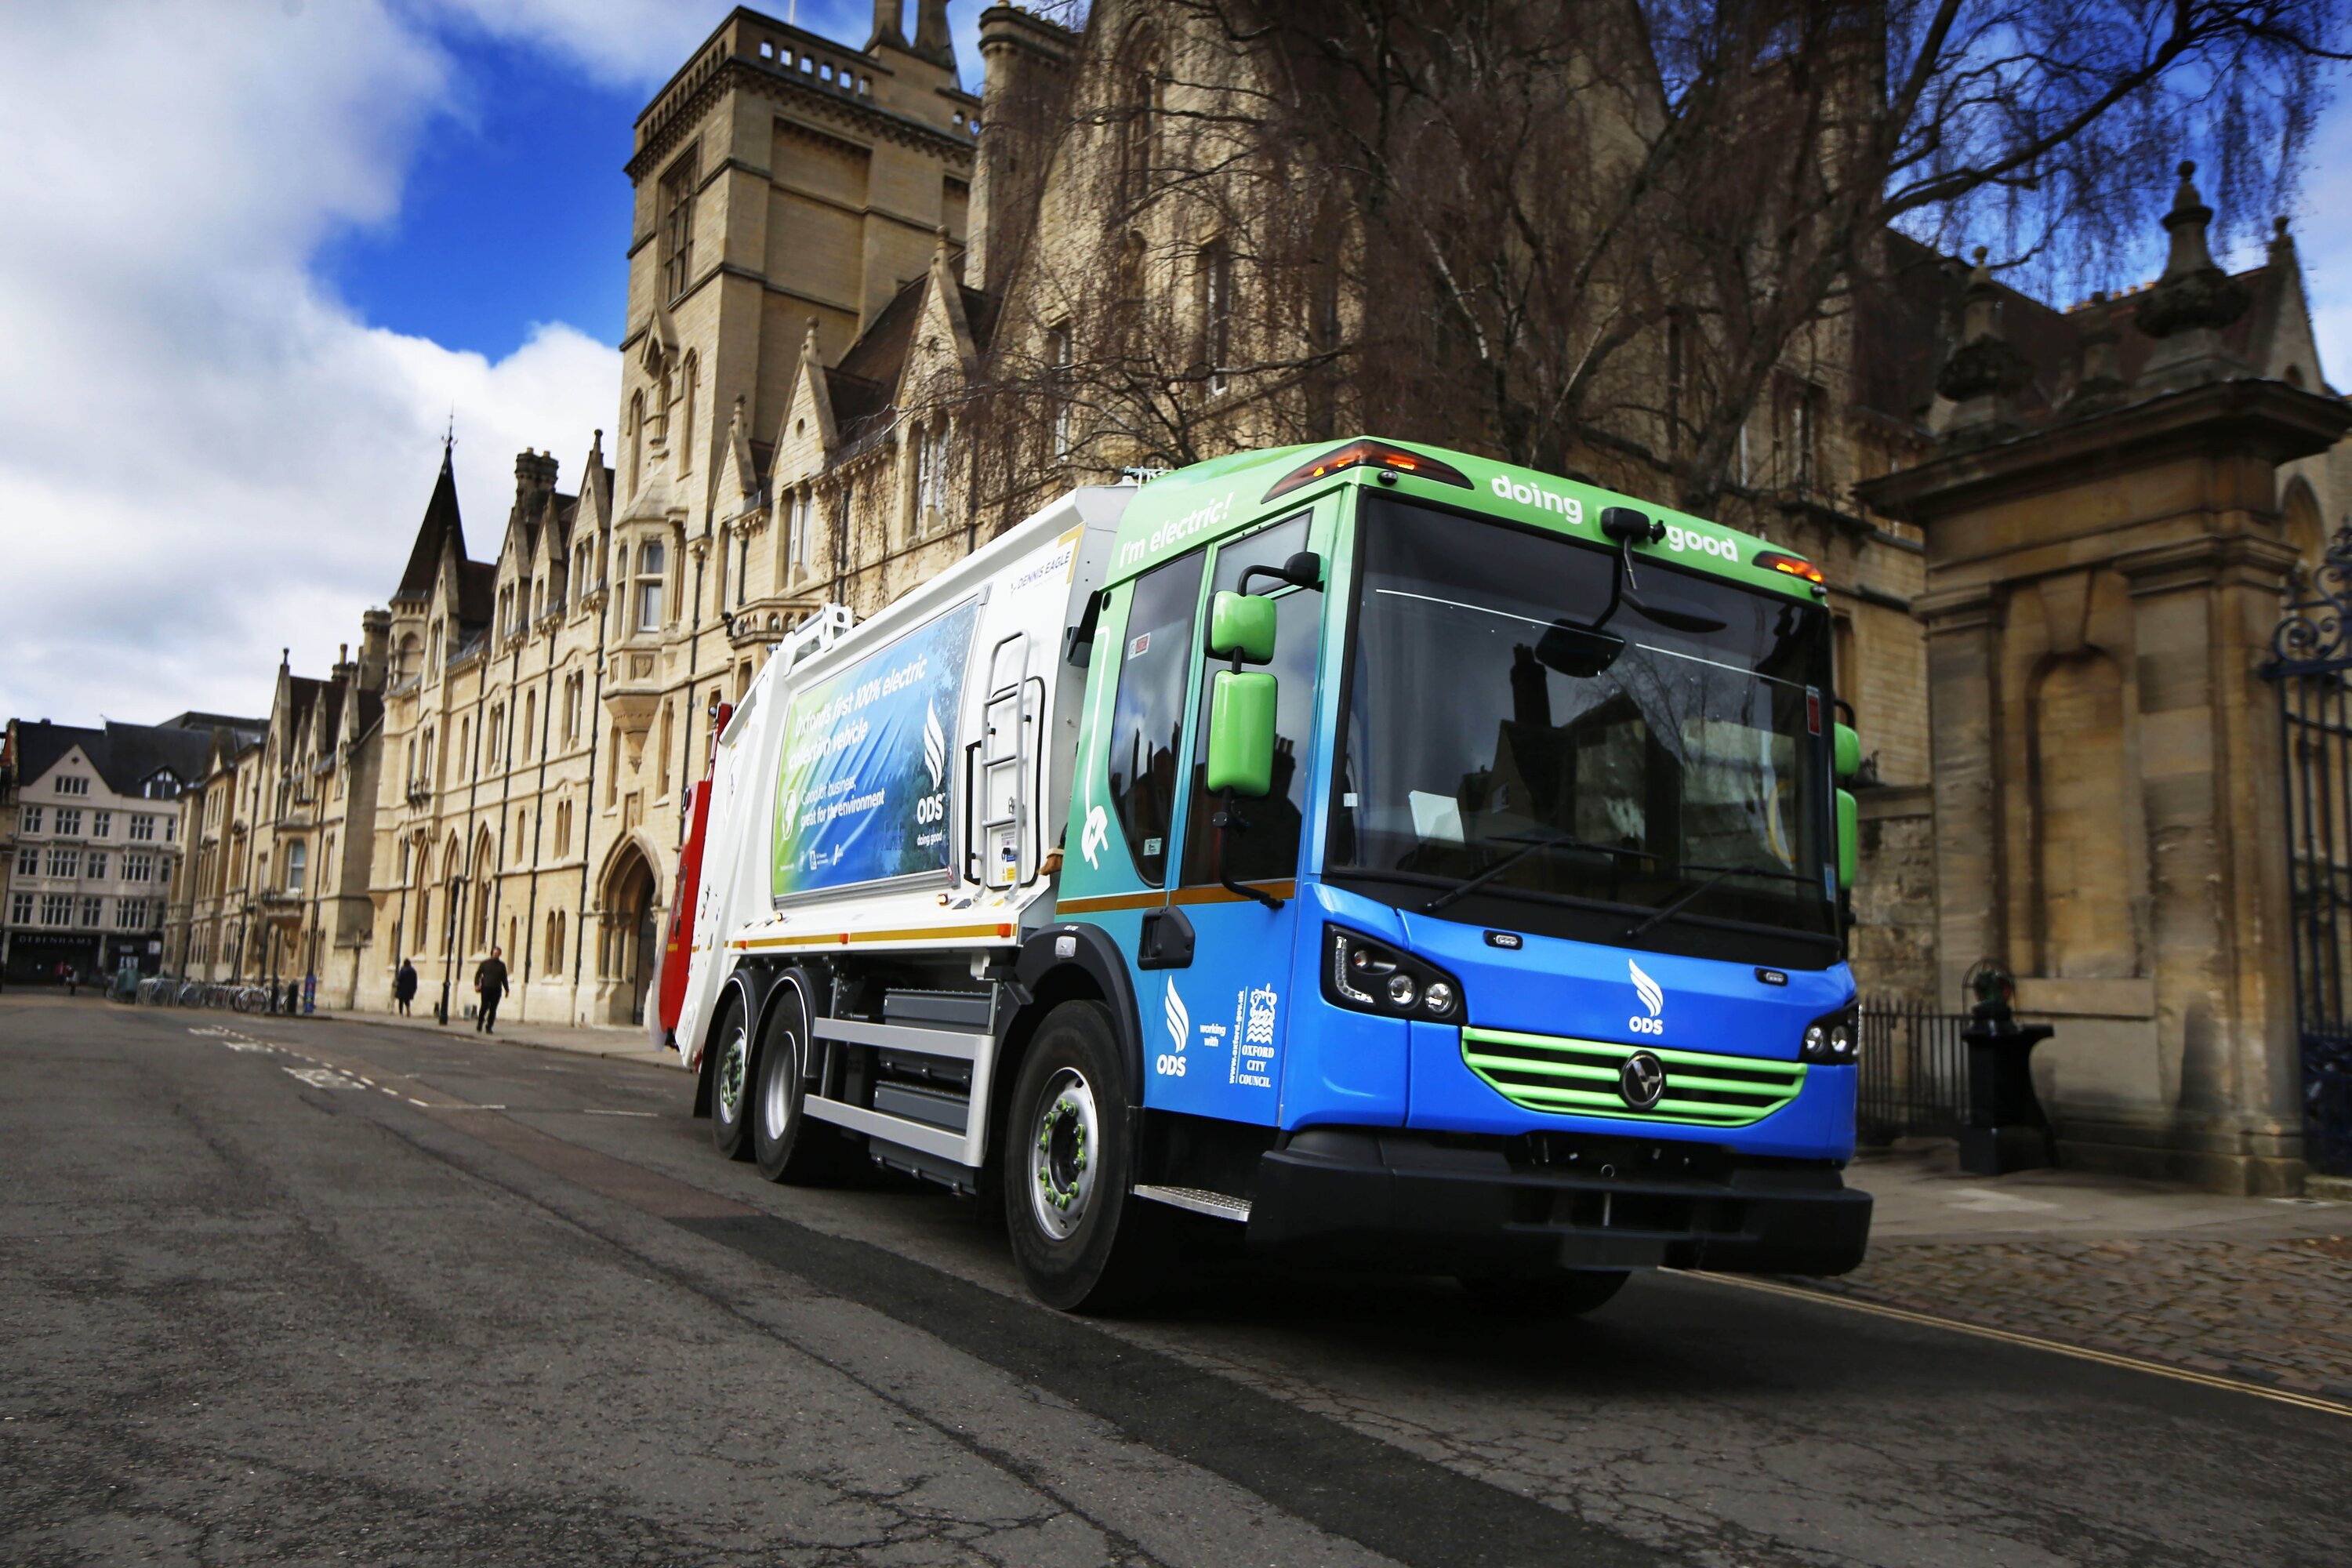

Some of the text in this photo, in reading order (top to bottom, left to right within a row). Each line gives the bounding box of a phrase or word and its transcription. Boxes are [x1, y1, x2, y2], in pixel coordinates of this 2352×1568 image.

[1491, 474, 1739, 562] doing good
[1119, 492, 1236, 569] I'm electric!
[1045, 551, 1071, 574] EAGLE
[832, 691, 855, 721] first
[854, 676, 882, 711] 100%
[882, 653, 927, 697] electric
[833, 717, 868, 753] vehicle
[800, 810, 816, 833] great
[817, 806, 827, 824] for
[837, 787, 885, 817] environment
[916, 829, 943, 846] doing good
[19, 935, 93, 946] DEBENHAMS
[1200, 1023, 1226, 1036] working
[1629, 1016, 1663, 1035] ODS
[1204, 1036, 1218, 1047] with
[1229, 990, 1245, 1083] www.oxford.gov.uk
[1242, 1044, 1275, 1058] OXFORD
[1156, 1054, 1186, 1077] ODS
[1247, 1060, 1266, 1072] CITY
[1239, 1074, 1271, 1087] COUNCIL
